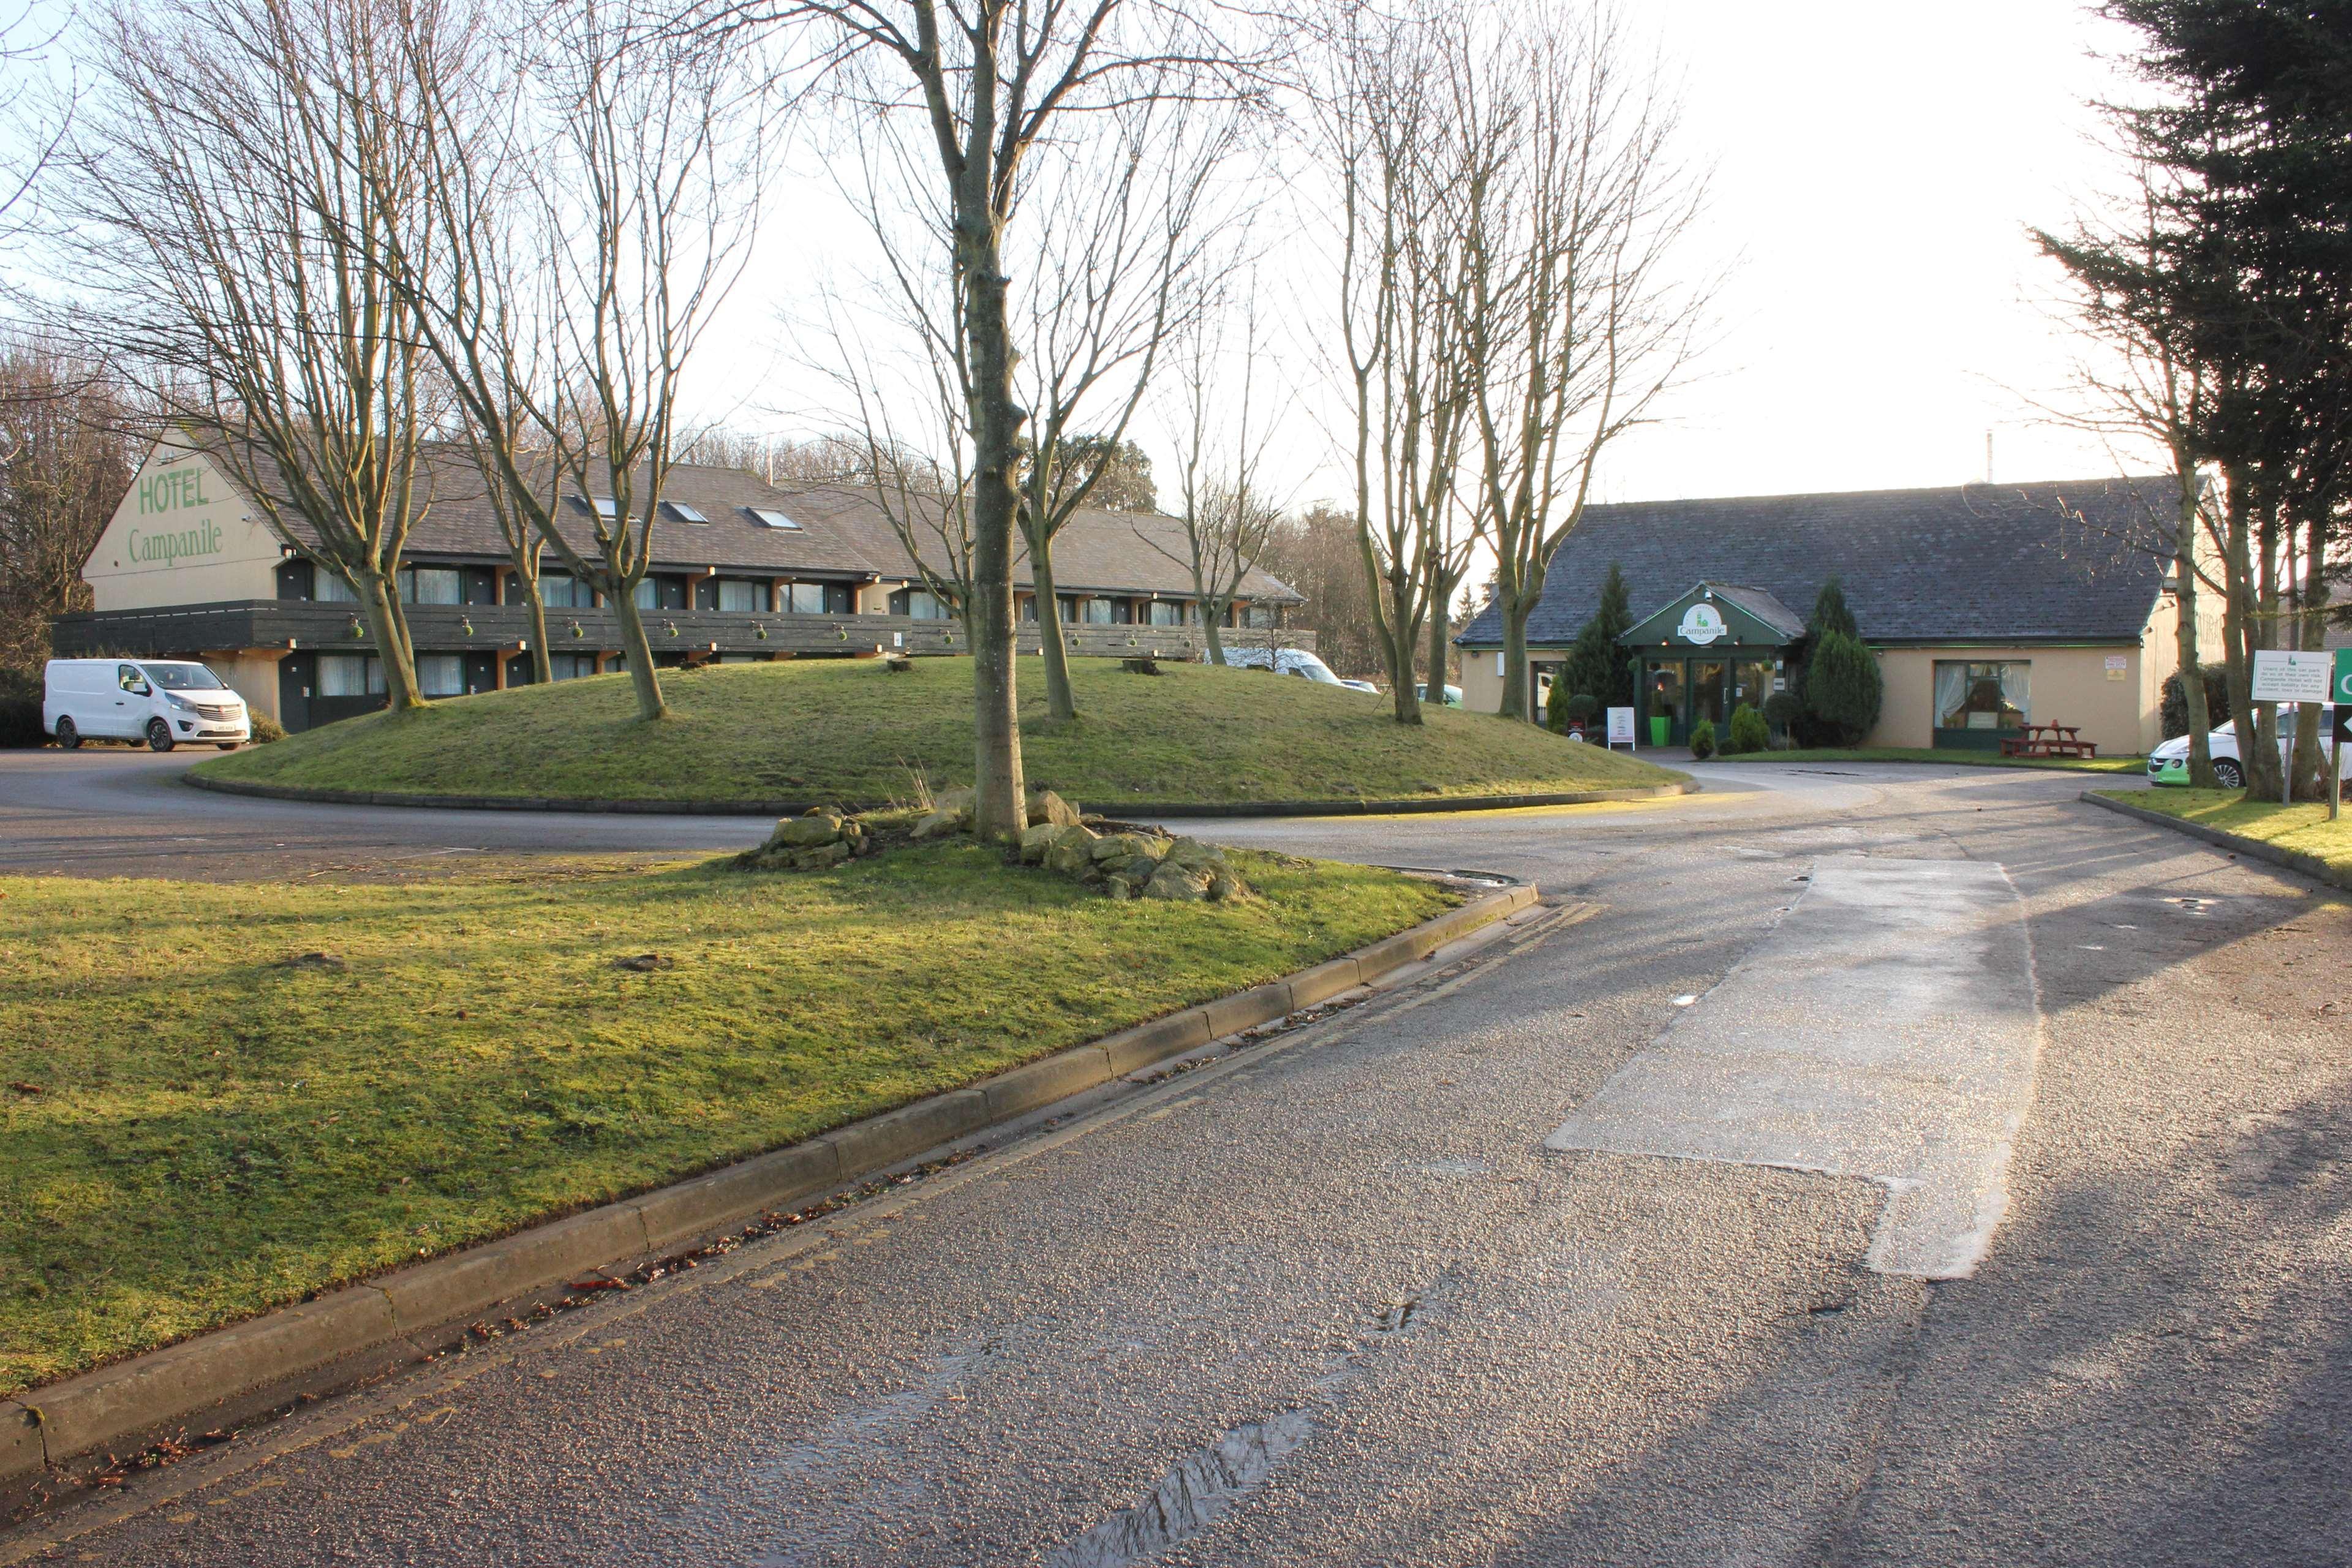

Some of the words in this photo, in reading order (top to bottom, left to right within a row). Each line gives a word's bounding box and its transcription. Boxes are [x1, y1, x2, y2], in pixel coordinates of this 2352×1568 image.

[140, 467, 209, 514] HOTEL
[129, 519, 222, 566] Campanile
[1680, 627, 1725, 636] Campanile
